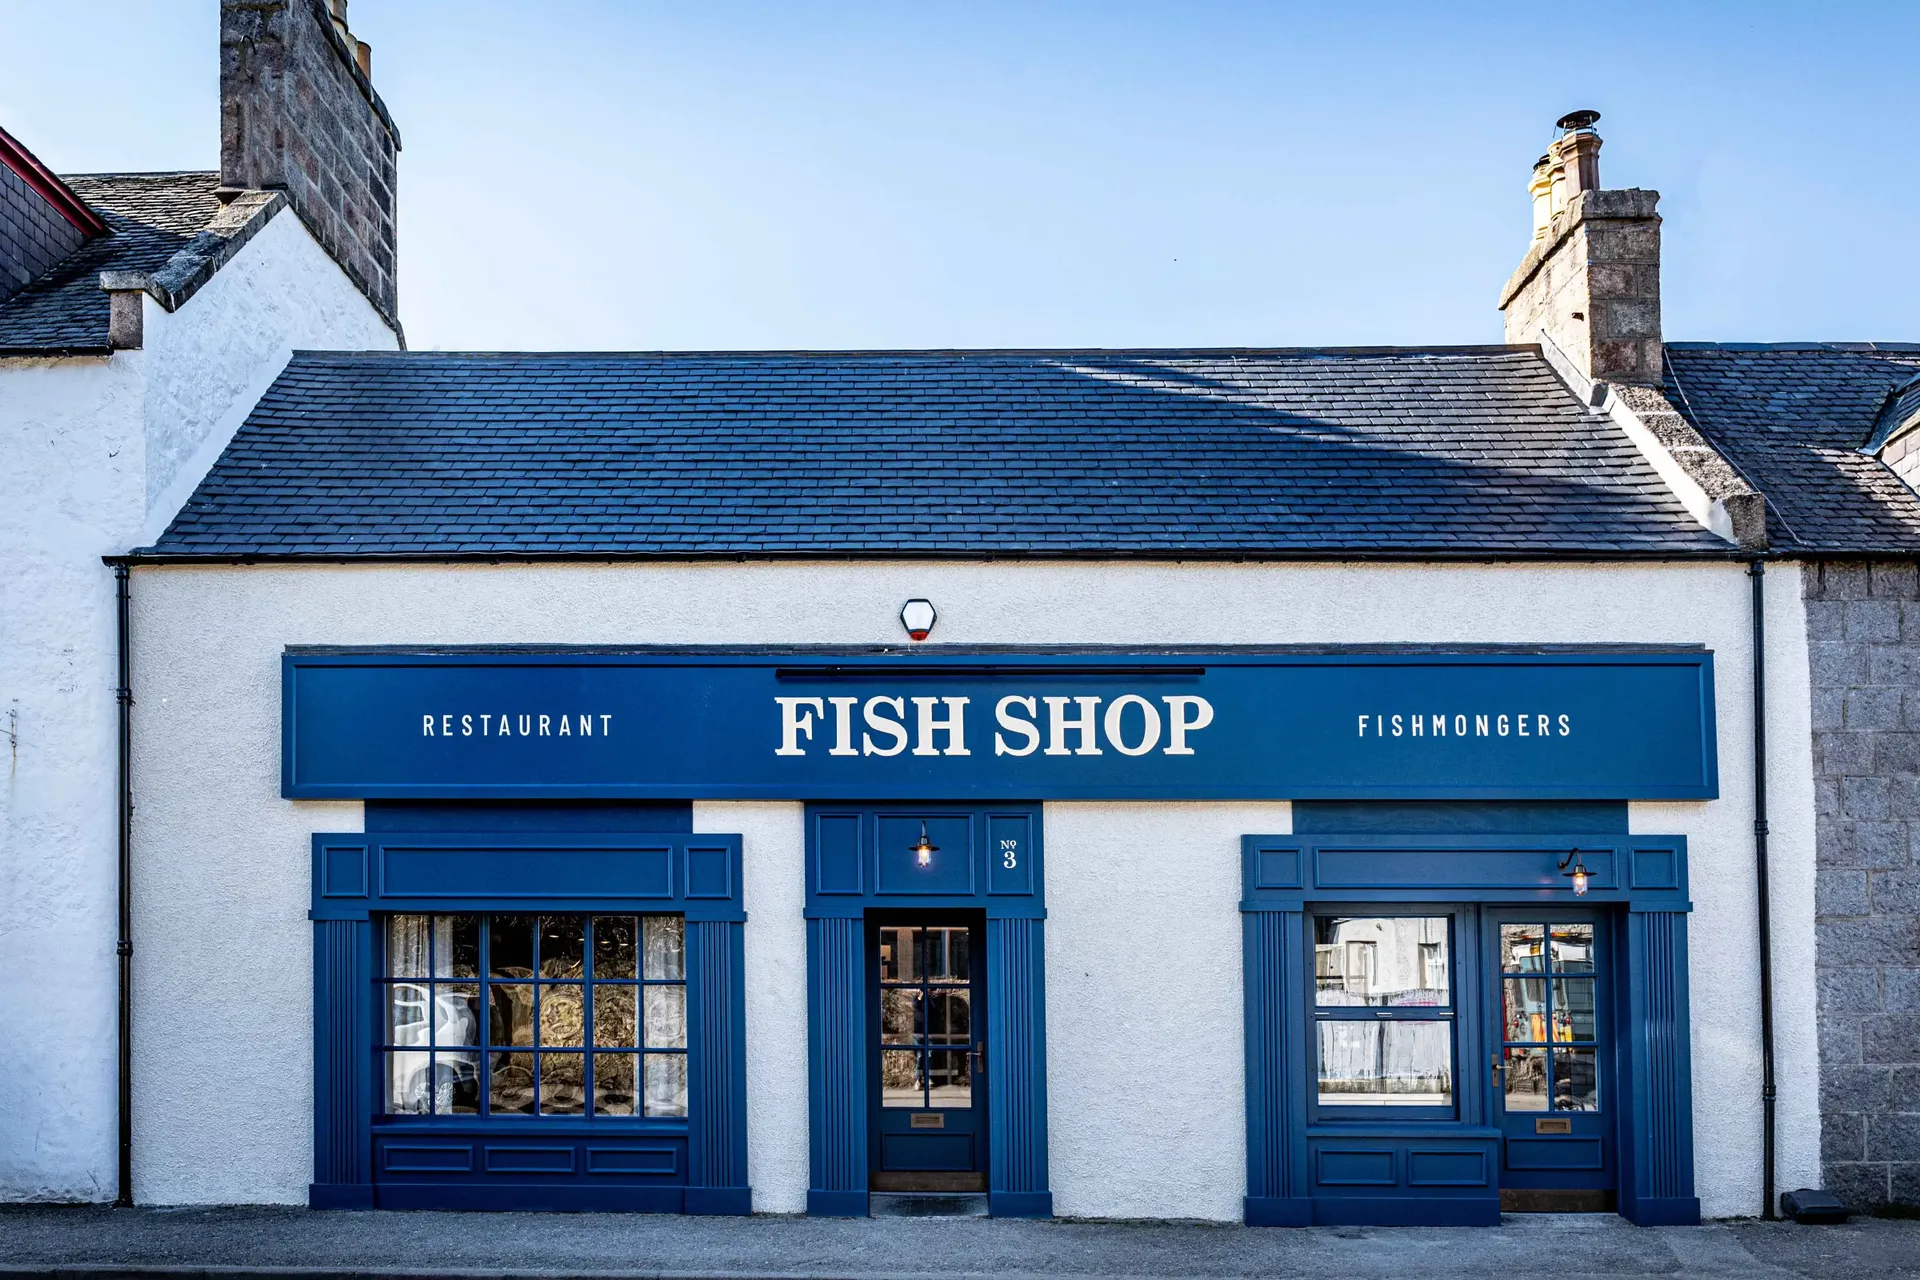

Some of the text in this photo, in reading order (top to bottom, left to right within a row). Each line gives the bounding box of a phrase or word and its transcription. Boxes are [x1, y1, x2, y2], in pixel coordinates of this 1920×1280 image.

[422, 714, 613, 737] RESTAURANT
[774, 694, 1214, 758] FISH SHOP
[1358, 713, 1571, 737] FISHMONGERS
[1003, 851, 1017, 869] 3
